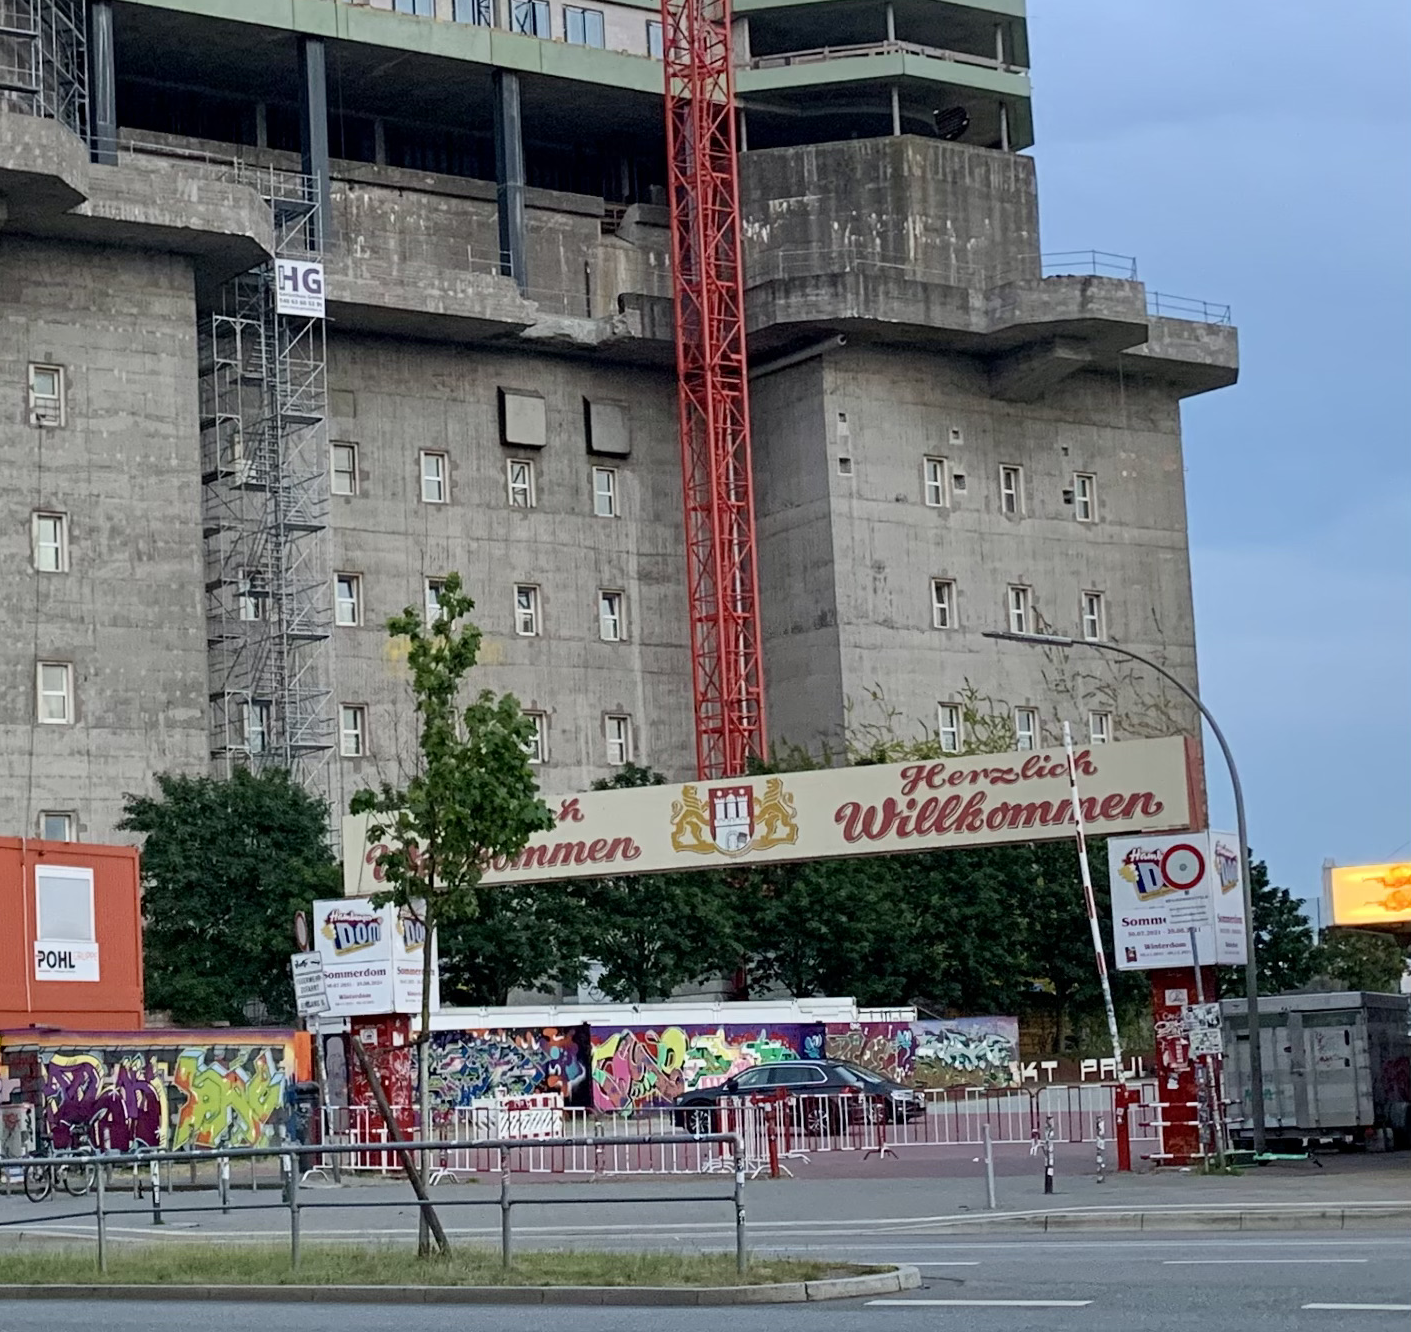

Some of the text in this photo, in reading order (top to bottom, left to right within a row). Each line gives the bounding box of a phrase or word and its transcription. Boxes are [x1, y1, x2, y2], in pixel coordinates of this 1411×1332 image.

[278, 265, 322, 294] HG
[900, 749, 1099, 796] Herzlich
[834, 791, 1165, 844] Willkommen
[37, 950, 76, 969] POHL
[323, 968, 387, 980] Sommerdom
